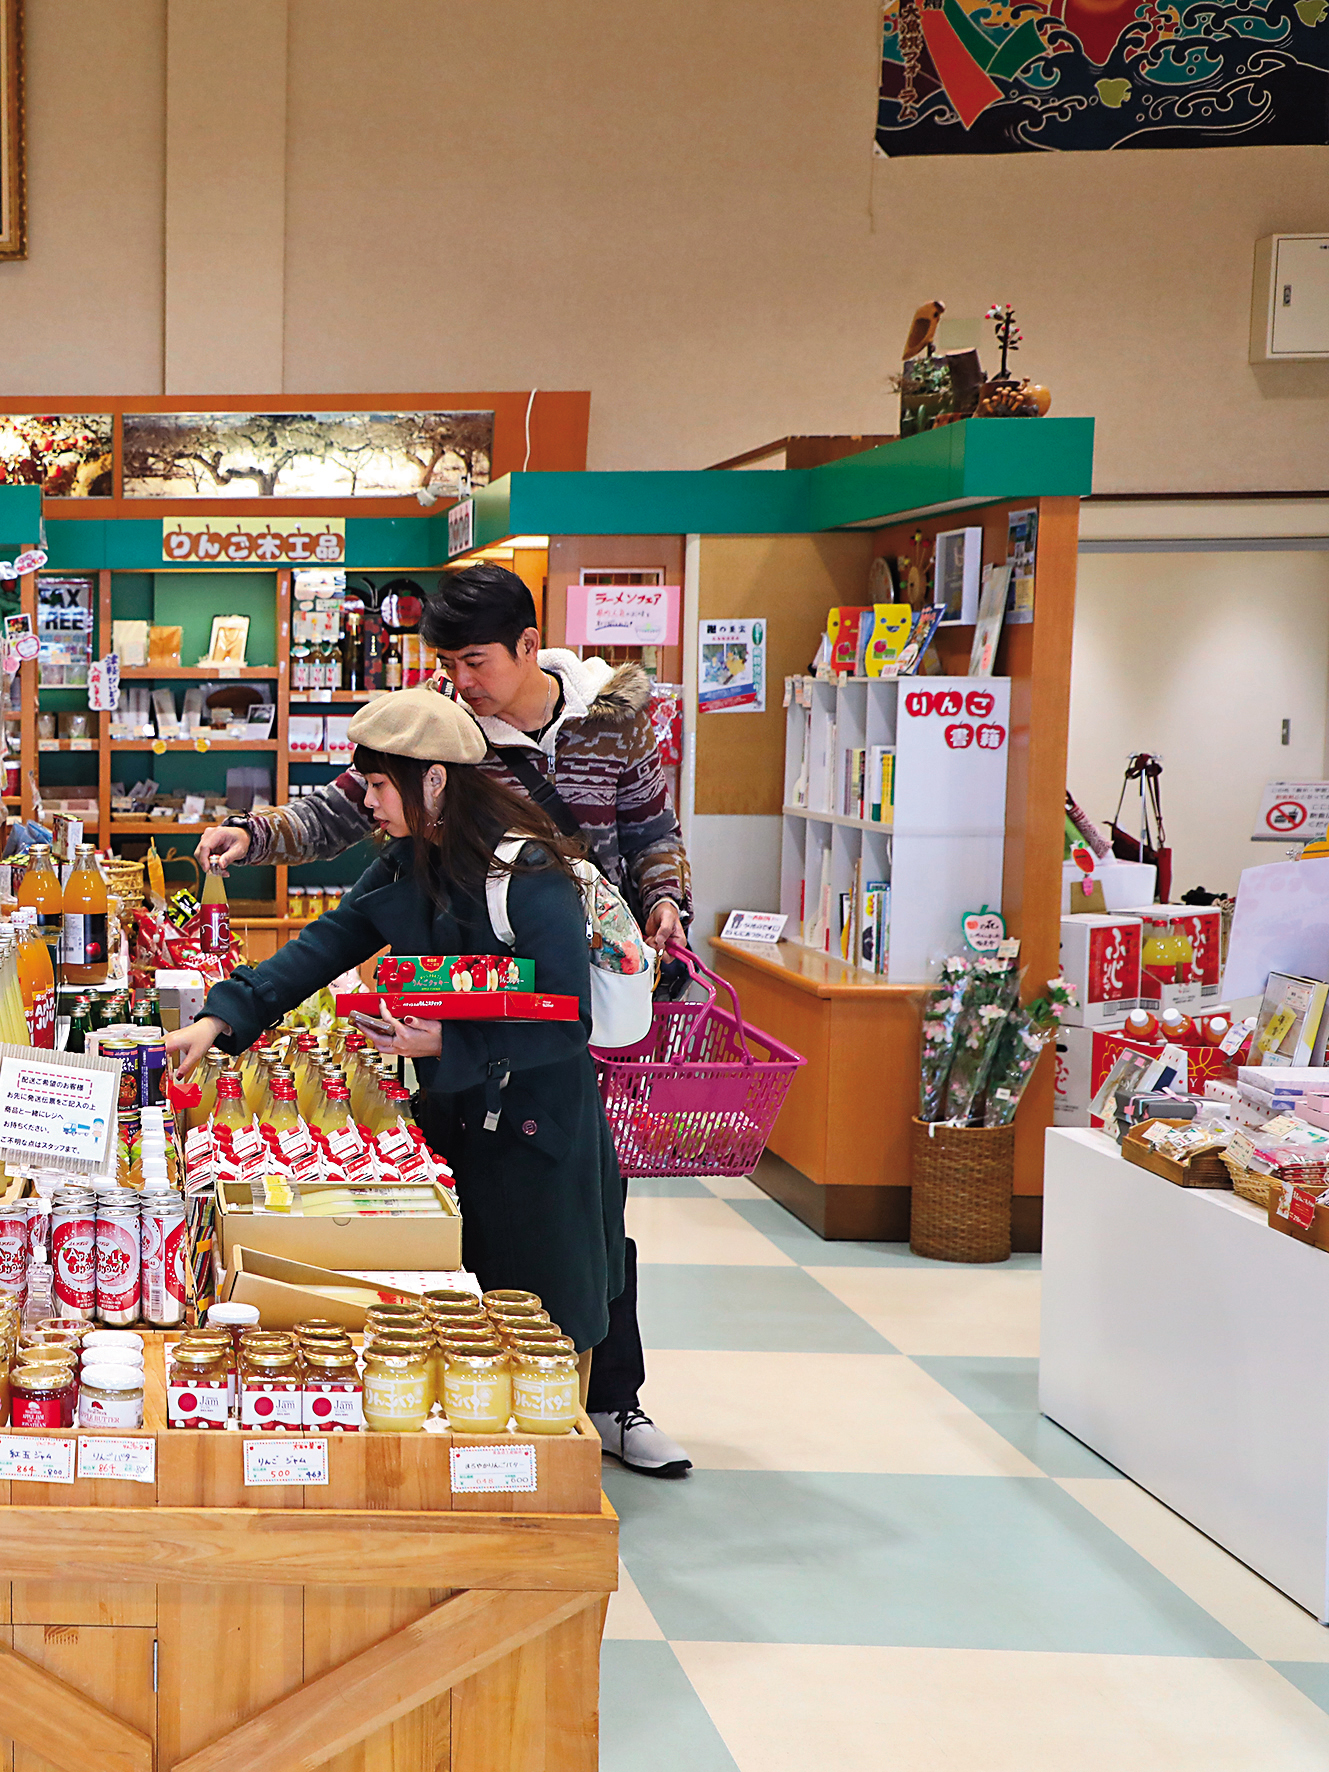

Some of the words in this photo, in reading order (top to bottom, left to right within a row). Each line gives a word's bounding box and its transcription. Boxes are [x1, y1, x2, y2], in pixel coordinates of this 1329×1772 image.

[897, 3, 923, 122] 大漁旗フォーラム
[170, 533, 342, 560] りんご木工品
[595, 592, 662, 606] ラーメンフェア
[949, 727, 1001, 748] 書籍
[1187, 917, 1207, 975] ふじ
[1105, 927, 1127, 989] ふじ
[21, 1076, 84, 1092] 配送ご希望のお客様
[7, 1091, 96, 1111] お先に発送伝票をご記入の上
[4, 1105, 64, 1120] 商品と一緒にレジへ
[3, 1121, 49, 1134] お持ちください。
[0, 1136, 80, 1154] ご不明な点はスタッフまで。
[199, 1395, 219, 1406] Jam
[276, 1399, 295, 1409] Jam
[334, 1399, 354, 1410] Jam
[92, 1452, 138, 1462] りんごバター
[16, 1465, 36, 1476] 864
[98, 1463, 116, 1473] 864
[305, 1470, 322, 1478] 463
